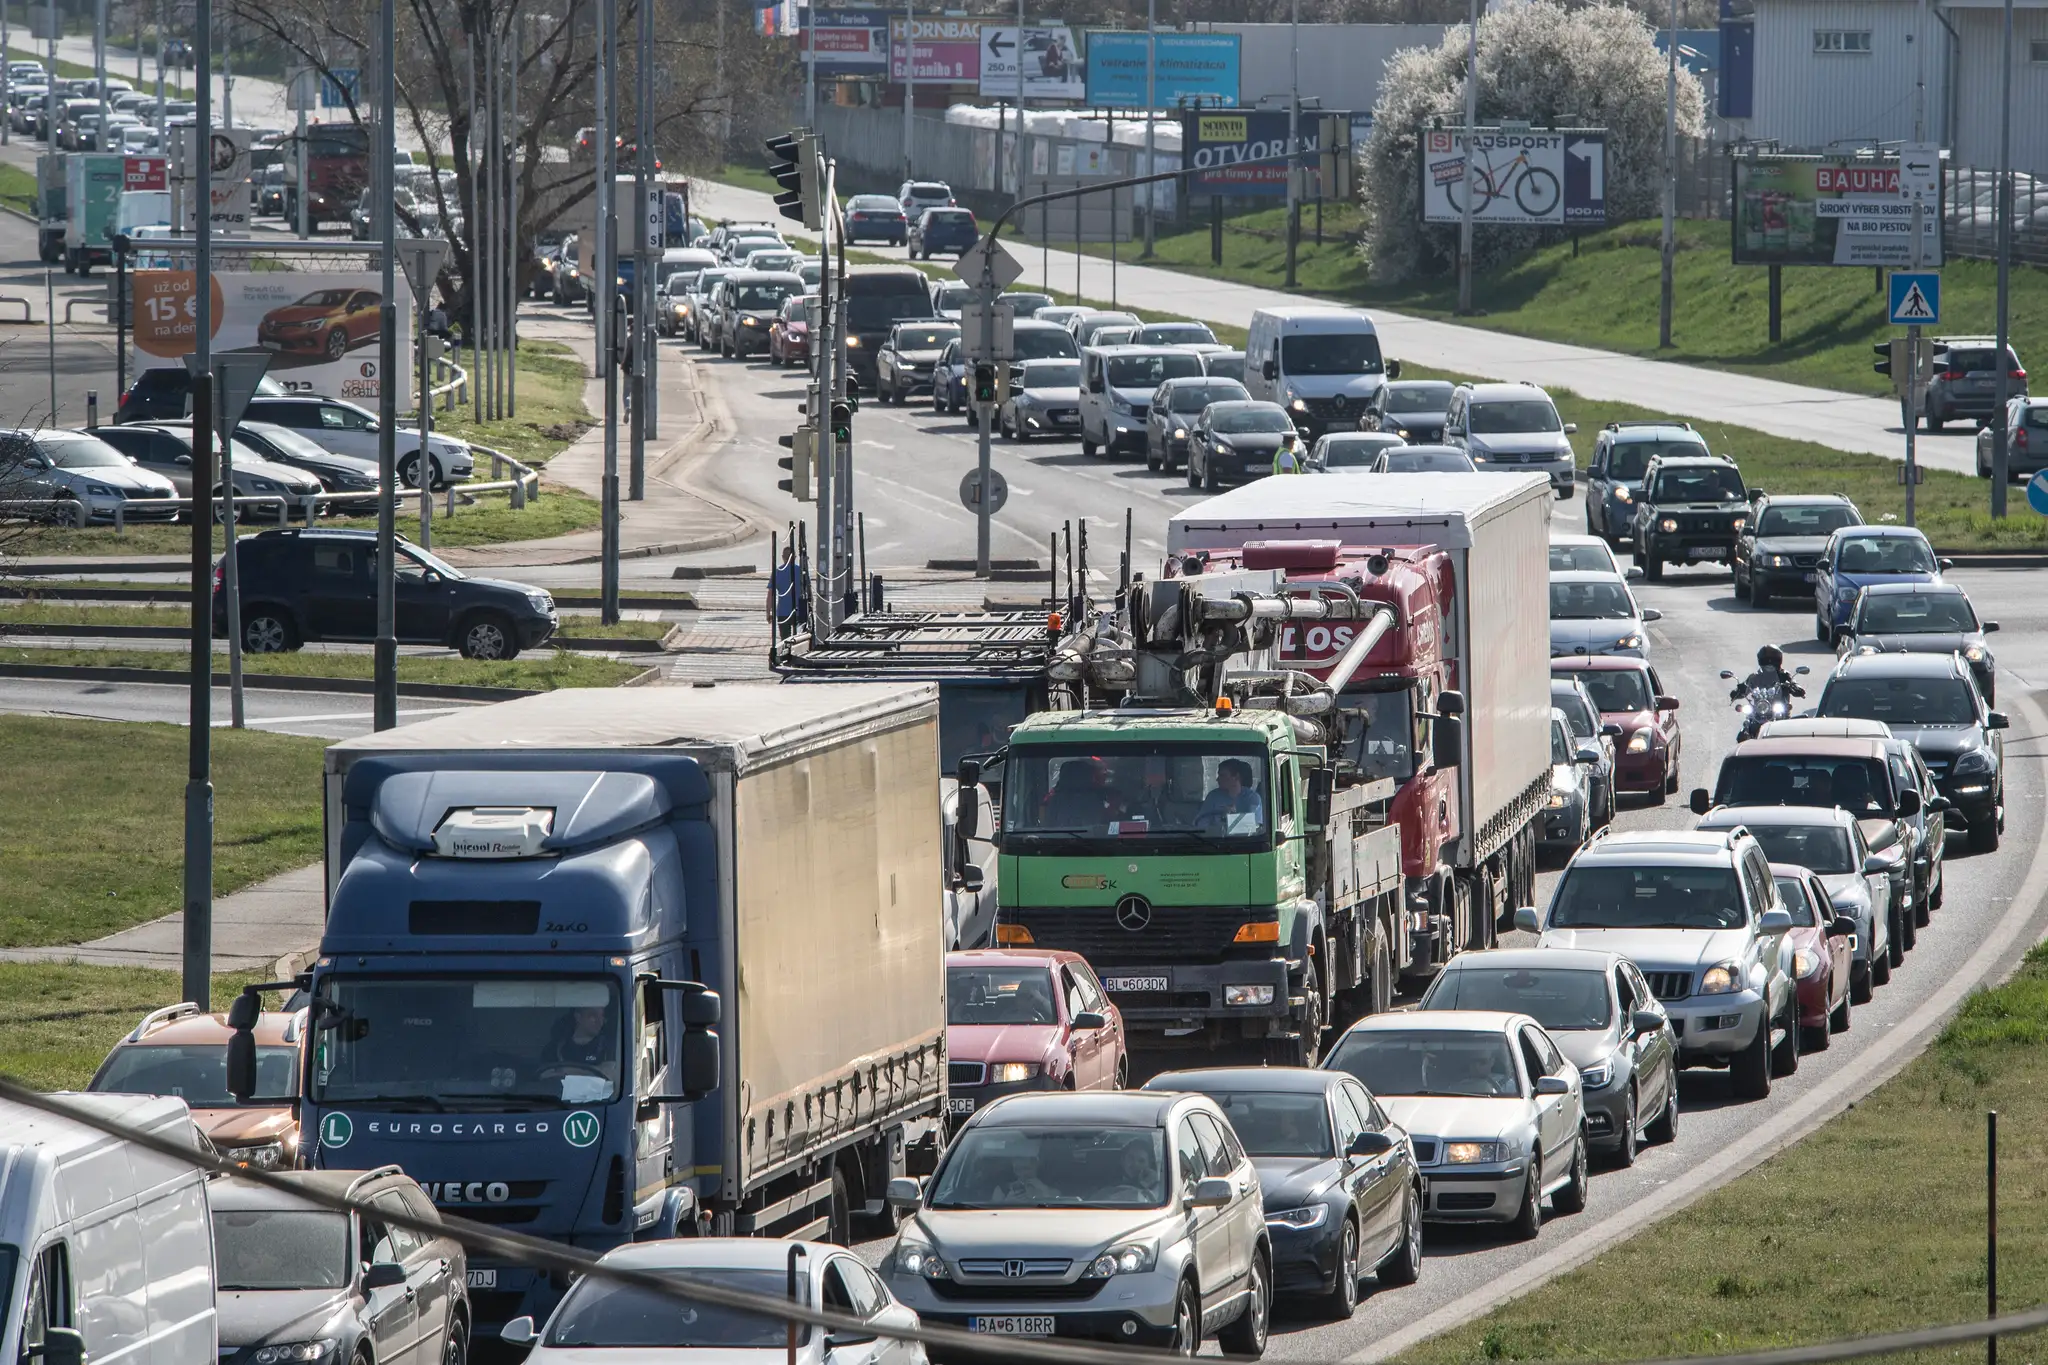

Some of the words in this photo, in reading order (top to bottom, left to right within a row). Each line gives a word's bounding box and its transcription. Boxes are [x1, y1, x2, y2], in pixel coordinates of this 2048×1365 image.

[893, 20, 981, 38] HORNBAC
[894, 43, 933, 58] Ruinov
[893, 61, 951, 77] Gavaniho
[955, 61, 964, 77] 9
[987, 63, 1005, 72] 250
[1203, 120, 1243, 131] SCONTO
[1224, 168, 1254, 180] firmy
[1256, 170, 1264, 179] a
[1819, 169, 1900, 188] BAUHA
[1566, 207, 1592, 216] 900
[1819, 201, 1850, 214] ŠIROKÝ
[1852, 202, 1880, 215] VÝBER
[1882, 204, 1936, 215] SUBSTROV
[190, 213, 244, 223] TMPUS
[1847, 221, 1860, 232] NA
[1862, 221, 1878, 232] BIO
[1879, 222, 1933, 233] PESTOVIE
[153, 281, 170, 293] už
[173, 278, 190, 292] od
[144, 296, 177, 321] 15
[183, 294, 197, 318] €
[154, 325, 171, 336] na
[343, 379, 380, 389] CENTR
[949, 1099, 973, 1112] 9CE
[368, 1121, 549, 1135] EUROCARGO
[569, 1119, 593, 1139] IV
[420, 1181, 510, 1203] VECO
[466, 1271, 495, 1287] 7DJ
